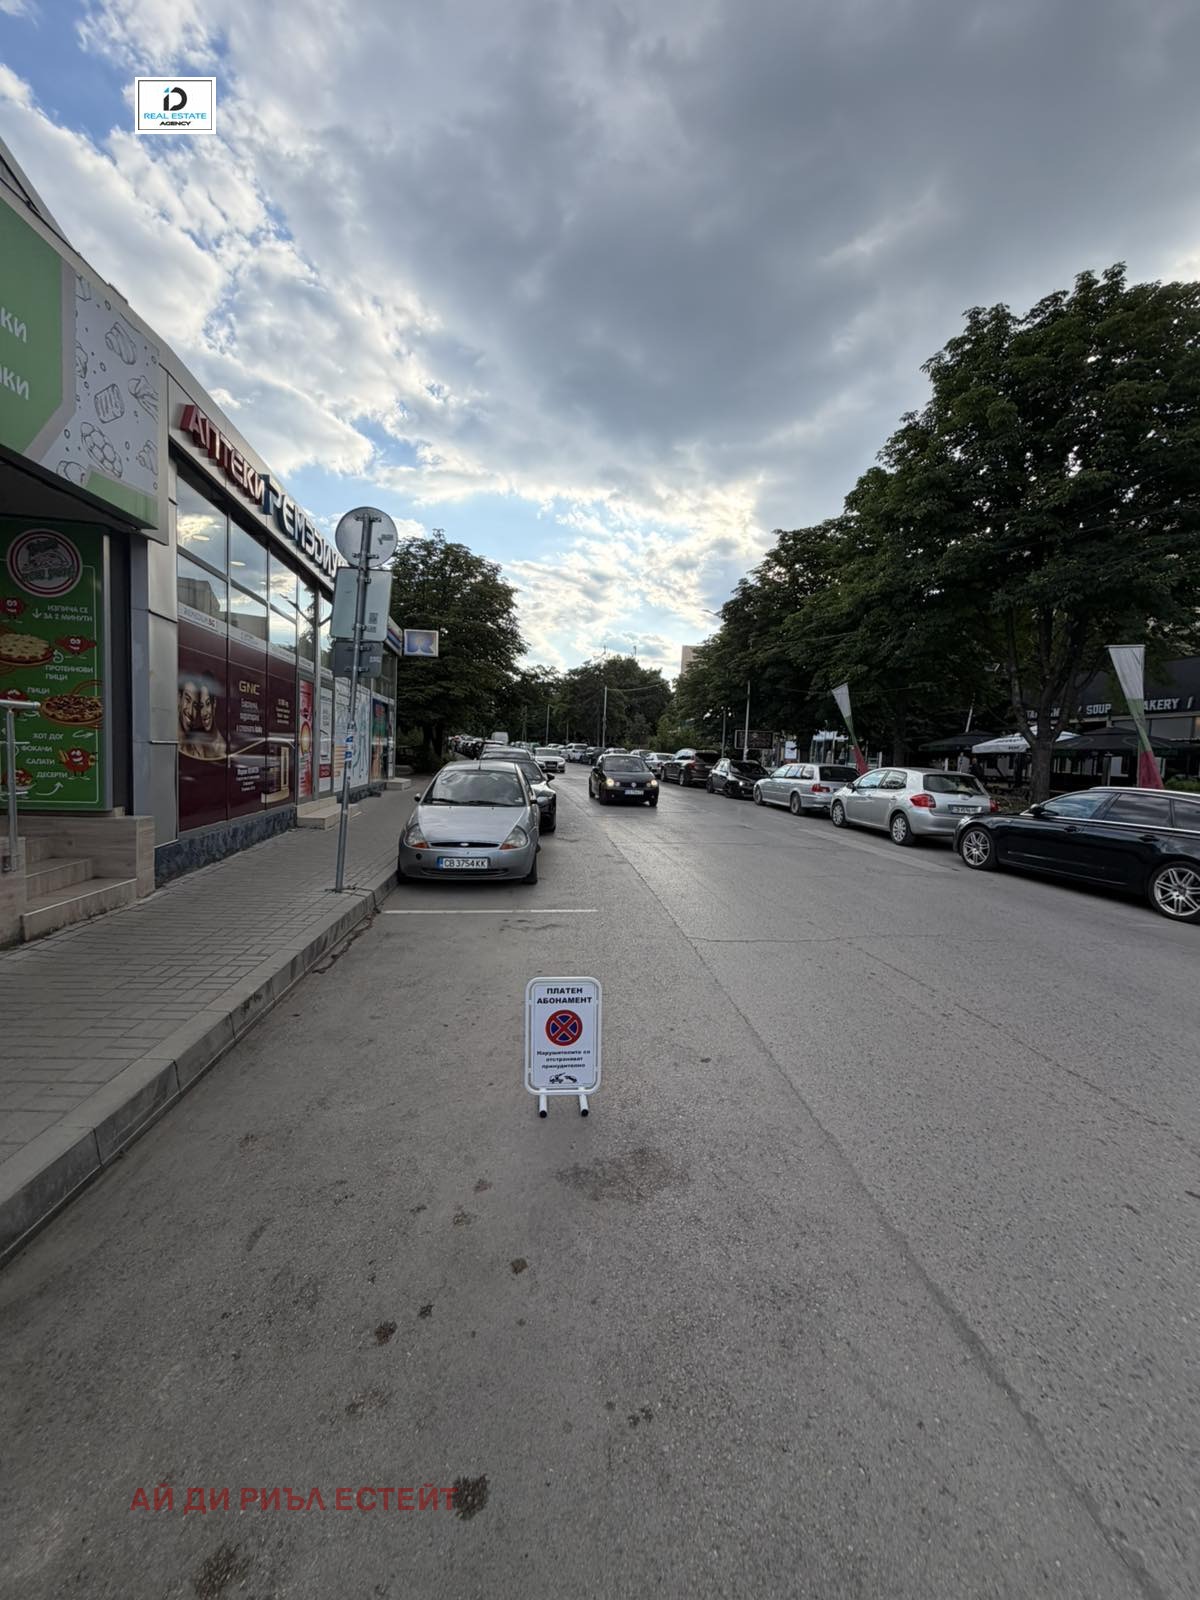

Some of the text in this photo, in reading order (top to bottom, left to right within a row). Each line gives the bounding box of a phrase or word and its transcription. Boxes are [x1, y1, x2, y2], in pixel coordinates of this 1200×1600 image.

[180, 404, 265, 505] АПТЕКИ
[45, 673, 68, 681] ПИЦИ
[27, 686, 50, 694] ПИЦИ
[239, 680, 260, 695] GNC
[1086, 703, 1111, 715] SOUP
[1143, 698, 1179, 711] AKERY
[25, 757, 55, 765] САЛАТИ
[546, 987, 583, 995] ПЛАТЕН
[536, 996, 593, 1005] АБОНАМЕНТ
